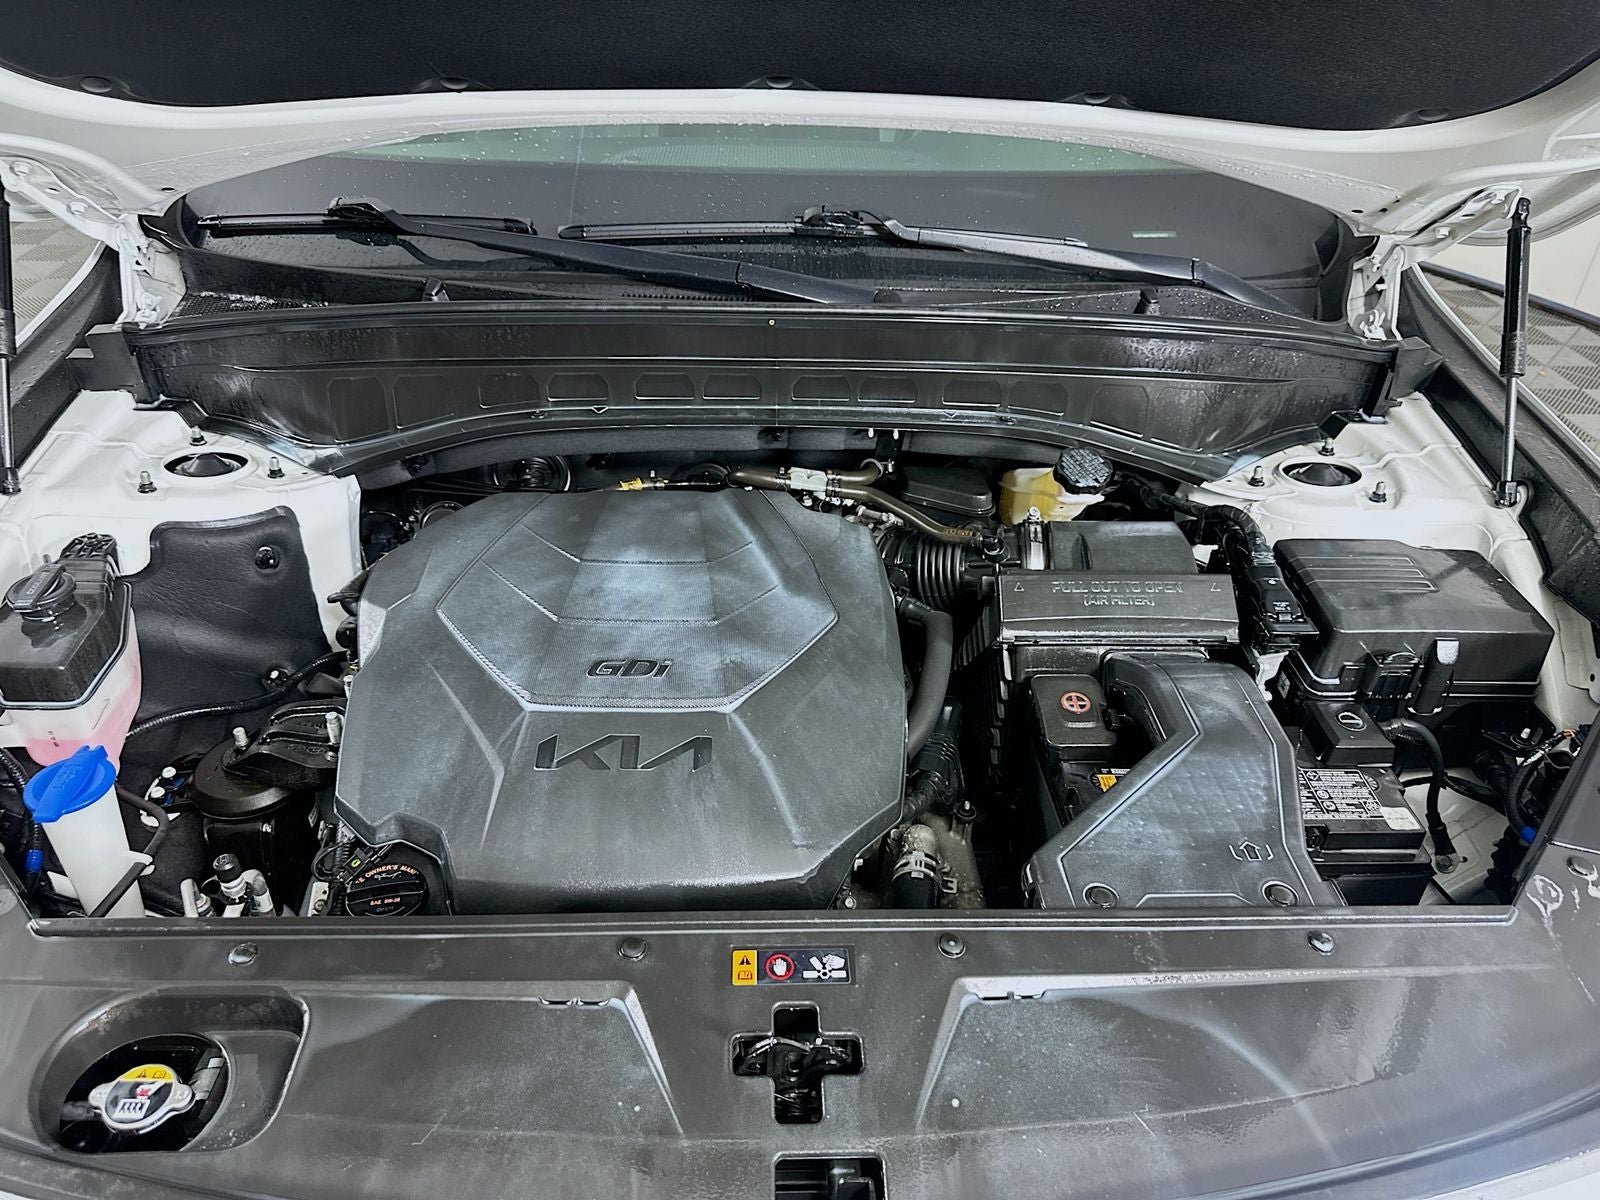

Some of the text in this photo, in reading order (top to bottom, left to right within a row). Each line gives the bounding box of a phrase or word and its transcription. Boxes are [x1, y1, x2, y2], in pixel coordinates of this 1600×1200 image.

[1051, 580, 1184, 593] PULL OUT TO OPEN
[586, 658, 673, 679] GDi
[533, 733, 714, 773] KIA
[365, 864, 398, 878] OWNER'S
